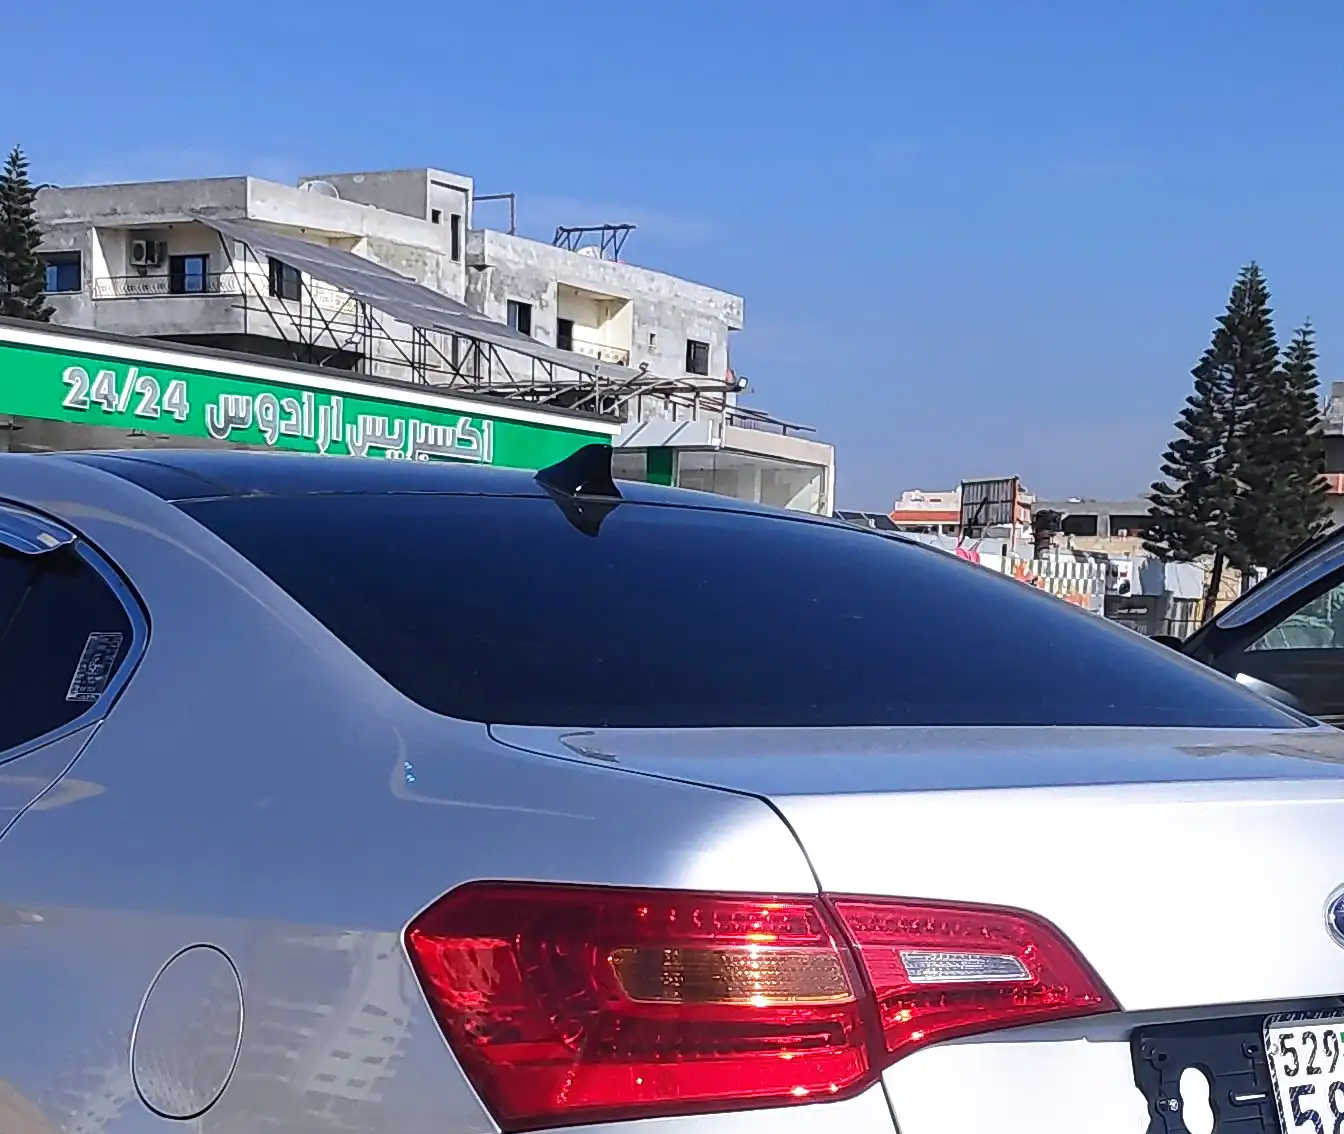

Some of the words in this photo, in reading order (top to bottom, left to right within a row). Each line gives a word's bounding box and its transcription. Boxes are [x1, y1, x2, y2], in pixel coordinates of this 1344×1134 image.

[61, 366, 190, 421] 24/24
[205, 391, 344, 455] ارادوس
[1279, 1029, 1340, 1077] 529
